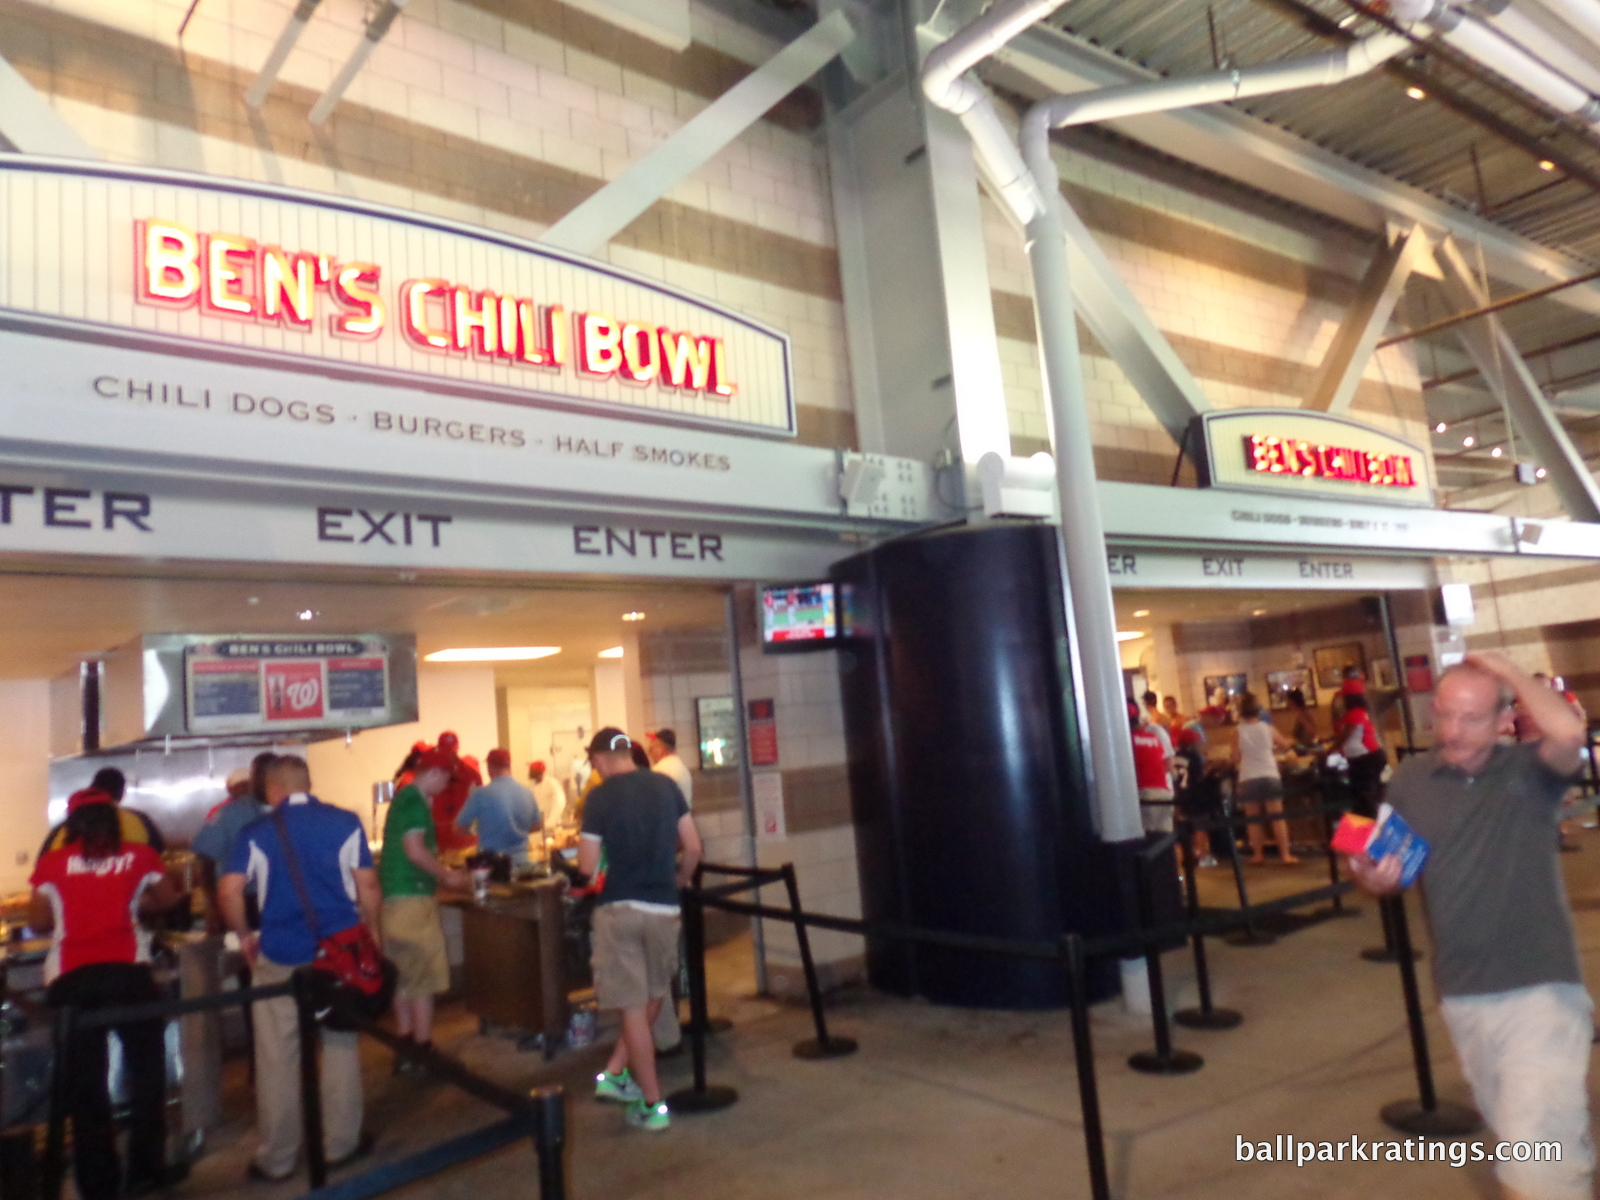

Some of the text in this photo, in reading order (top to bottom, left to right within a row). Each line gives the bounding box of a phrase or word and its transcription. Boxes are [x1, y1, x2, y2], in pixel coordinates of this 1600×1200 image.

[133, 217, 738, 402] BEN'S CHILI BOWL
[92, 375, 731, 472] CHILI DOGS BURGERS HALF SMOKES
[316, 505, 453, 548] EXIT
[571, 524, 725, 562] ENTER
[1202, 557, 1245, 577] EXIT
[1299, 560, 1354, 579] ENTER
